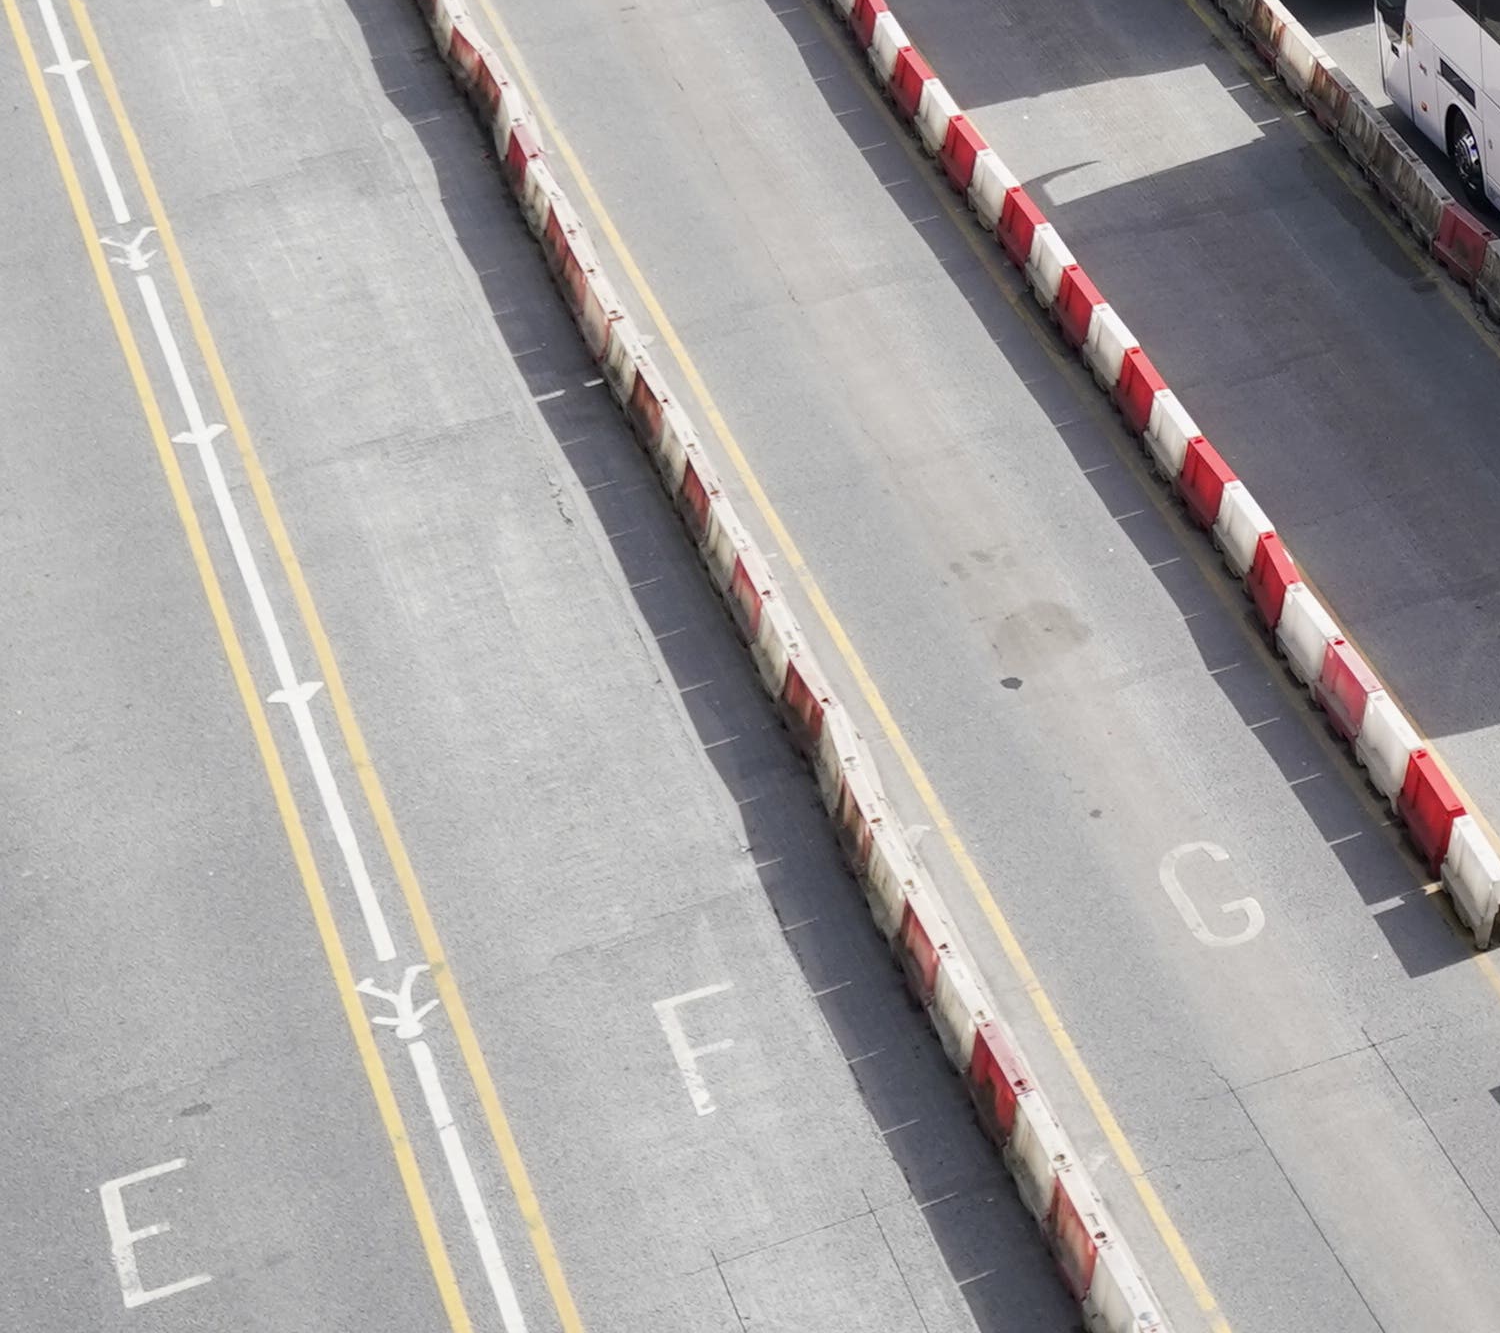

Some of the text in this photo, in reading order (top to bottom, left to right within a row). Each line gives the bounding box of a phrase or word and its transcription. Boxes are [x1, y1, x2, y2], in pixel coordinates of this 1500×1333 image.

[1159, 842, 1269, 949] G
[651, 982, 736, 1118] F
[98, 1158, 212, 1311] E
